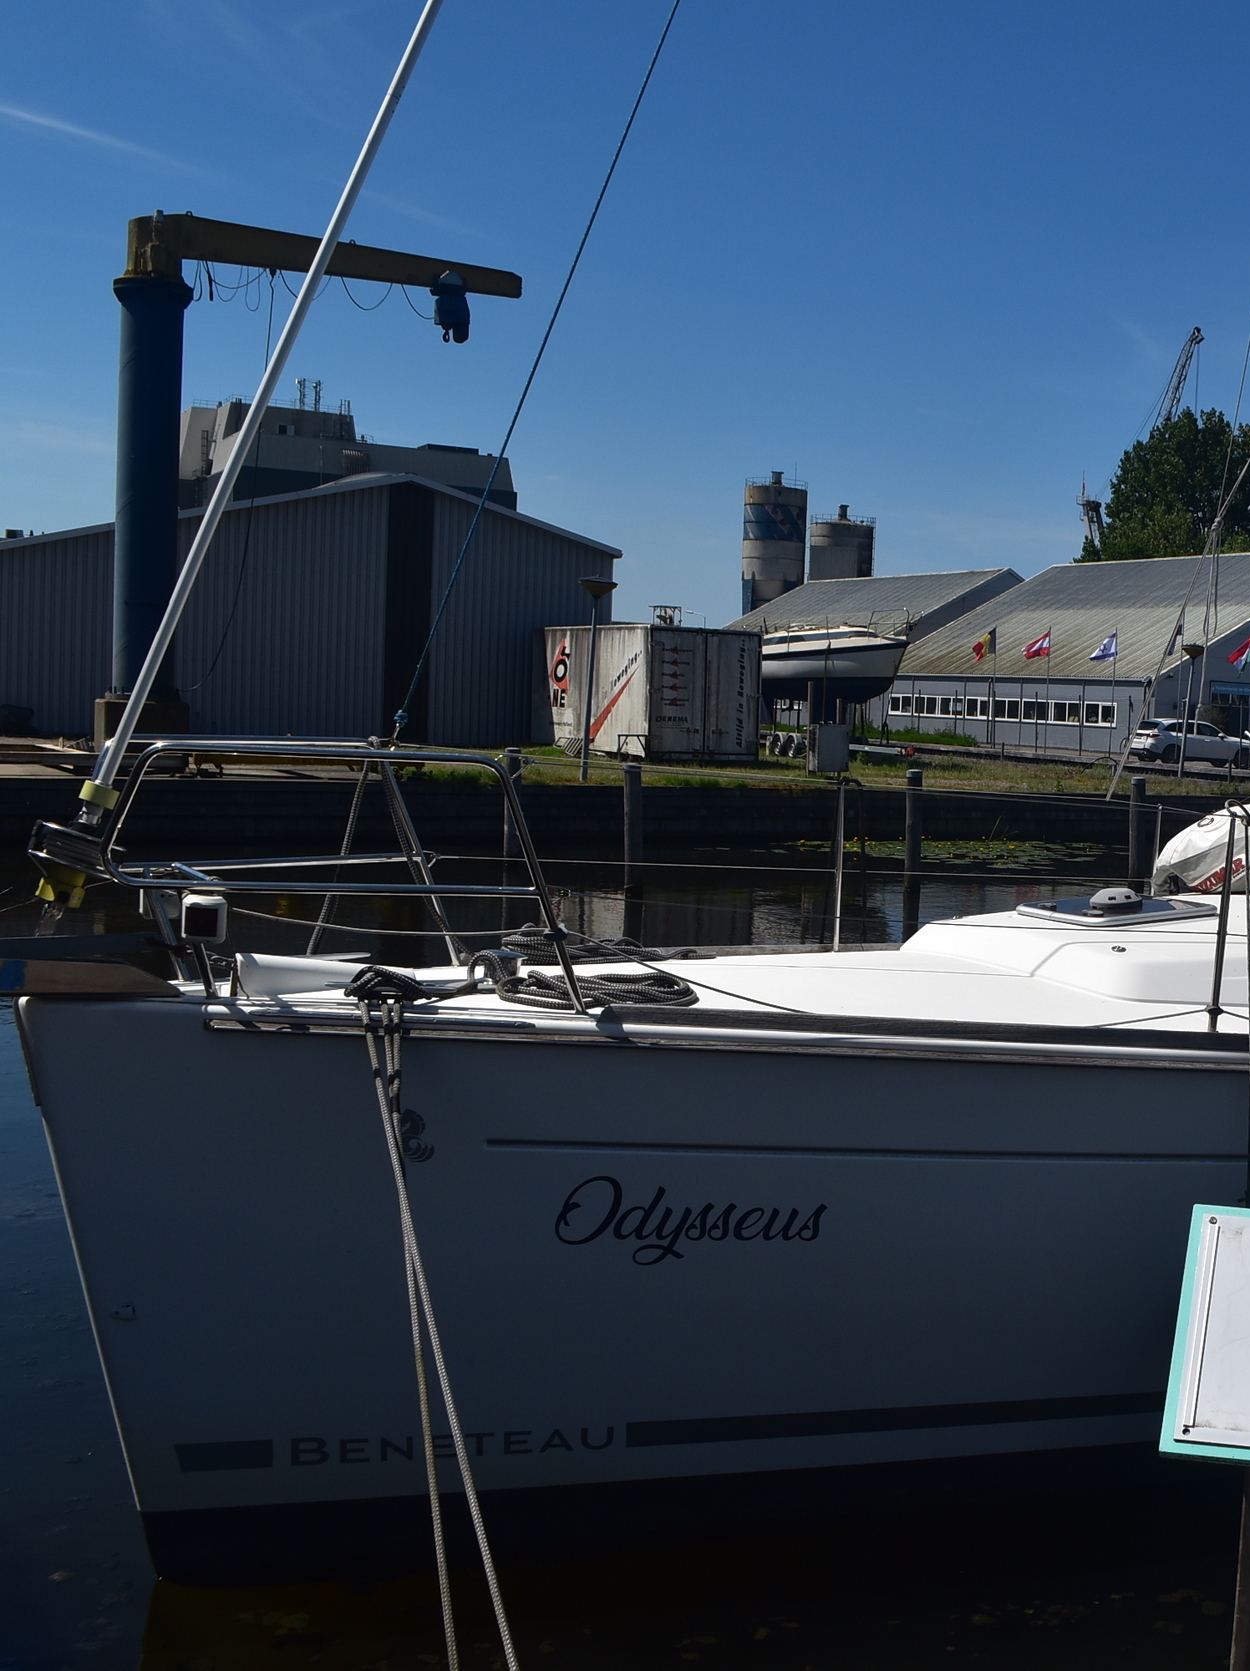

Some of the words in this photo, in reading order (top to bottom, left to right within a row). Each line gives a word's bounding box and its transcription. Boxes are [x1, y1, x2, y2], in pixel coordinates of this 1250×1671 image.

[736, 717, 744, 749] Altijd
[554, 1175, 828, 1266] Odysseus
[290, 1426, 615, 1467] BENETEAU
